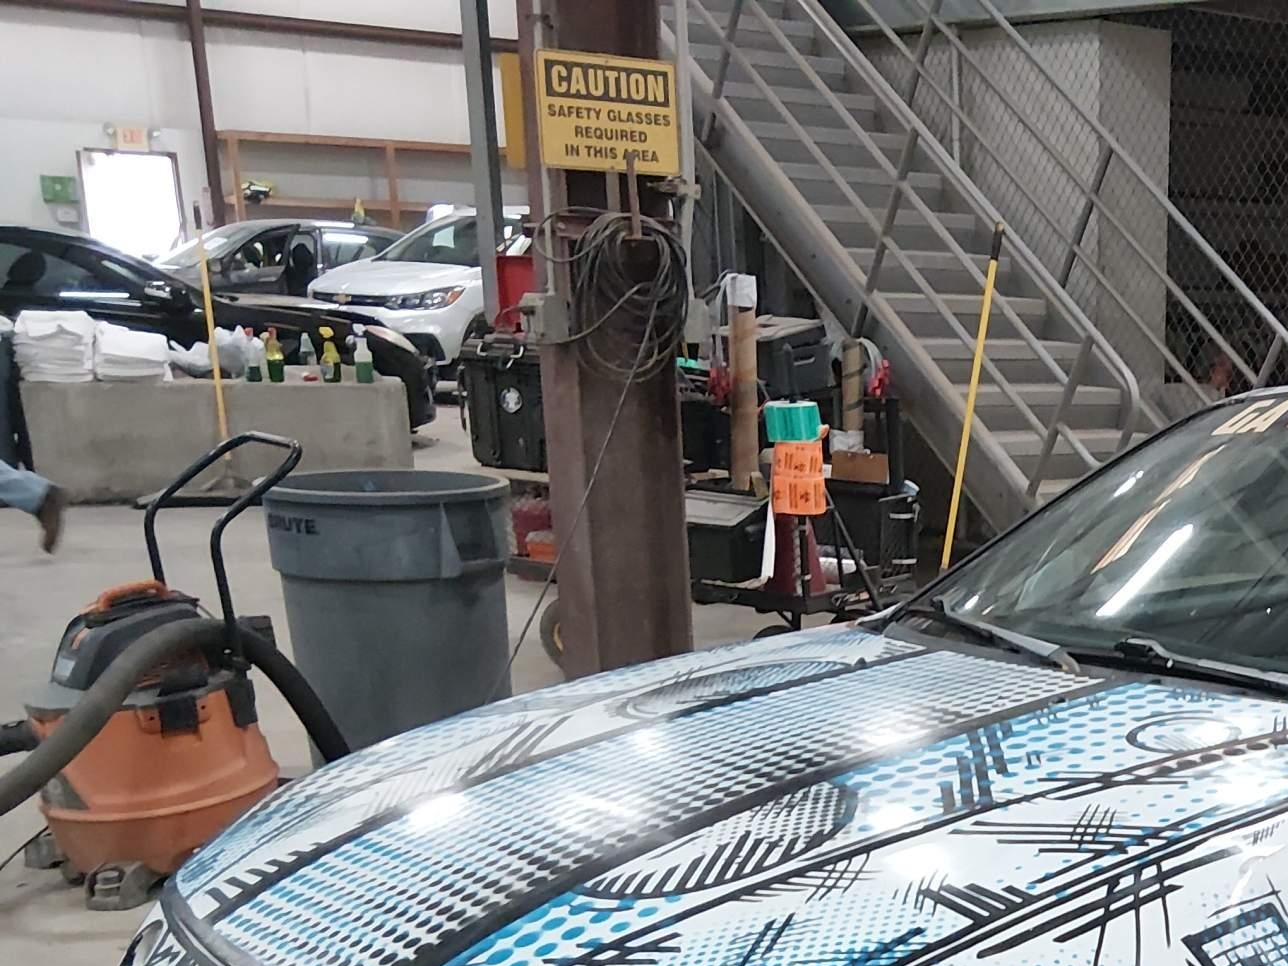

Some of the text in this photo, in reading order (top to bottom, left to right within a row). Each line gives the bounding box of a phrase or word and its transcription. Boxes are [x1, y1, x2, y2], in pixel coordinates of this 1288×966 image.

[550, 64, 666, 103] CAUTION
[547, 103, 671, 127] SAFETY GLASSES
[574, 125, 648, 143] REQUIRED
[564, 143, 580, 157] IN
[584, 145, 618, 160] THIS
